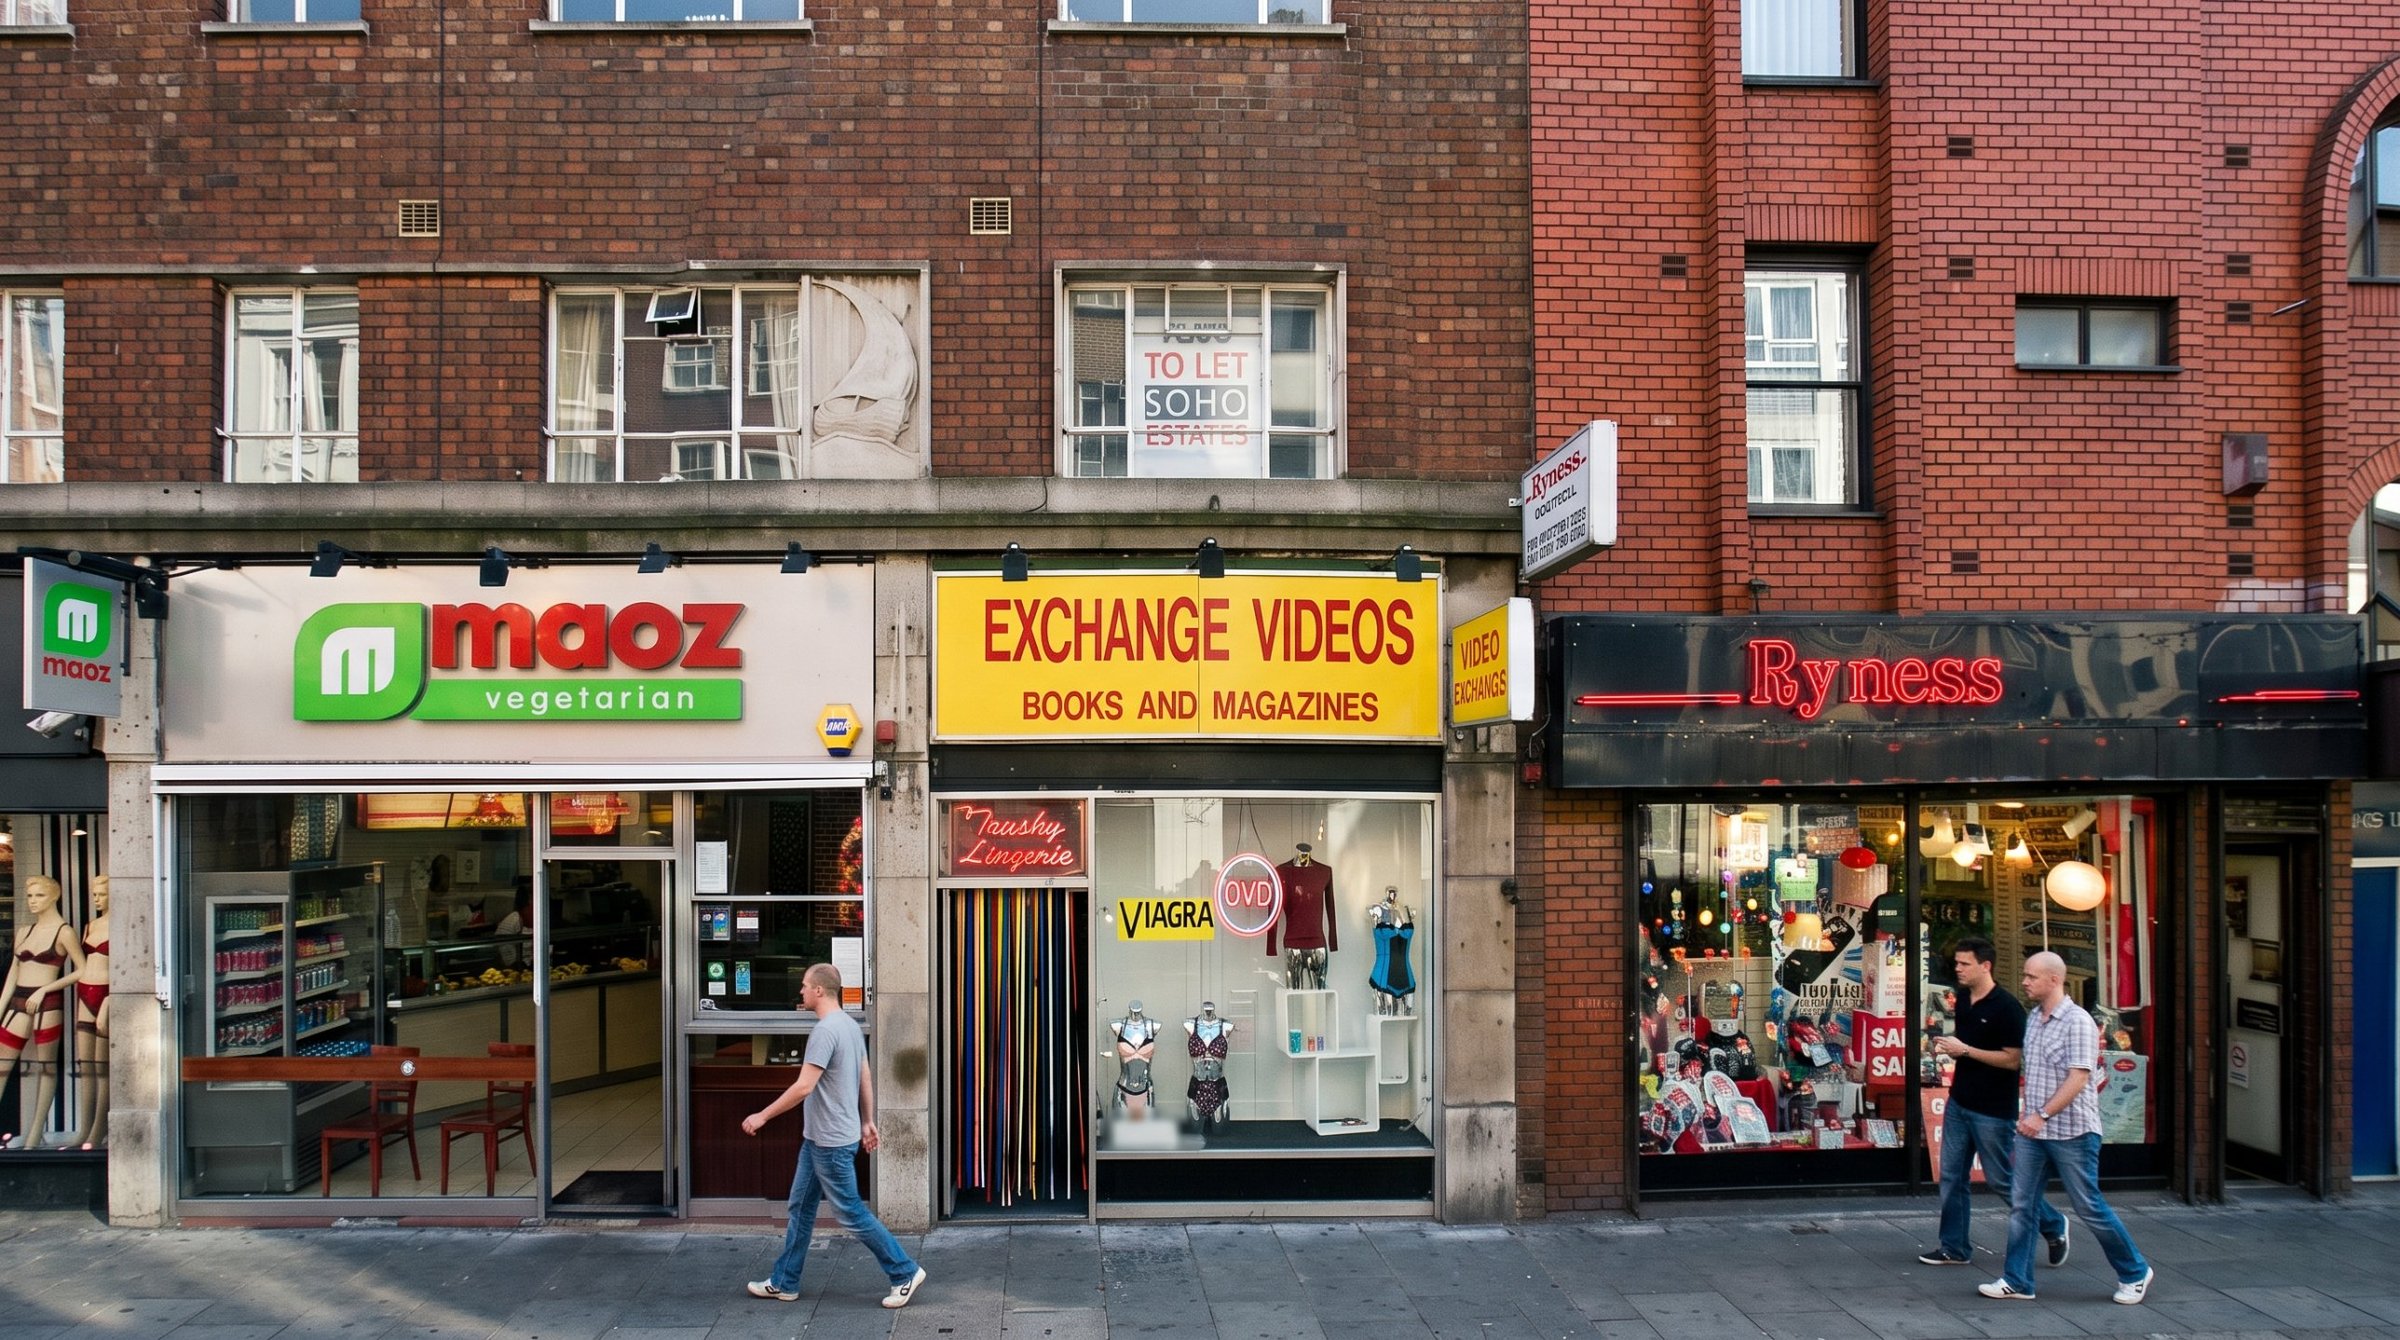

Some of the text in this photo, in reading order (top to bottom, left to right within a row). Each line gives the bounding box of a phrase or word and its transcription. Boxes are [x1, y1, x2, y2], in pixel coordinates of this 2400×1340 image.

[1144, 351, 1249, 379] TO LET
[1145, 388, 1247, 417] SOHO
[1146, 424, 1249, 446] ESTATES
[1531, 450, 1581, 500] Ryness
[432, 602, 746, 670] maoz
[984, 596, 1415, 666] EXCHANGE VIDEOS
[1460, 629, 1500, 671] VIDEO
[42, 655, 112, 683] maoz
[1750, 638, 2003, 718] Ryness
[485, 685, 695, 715] vegetarian
[1022, 690, 1379, 723] BOOKS AND MAGAZINES
[959, 840, 1074, 873] Lingerie
[1119, 901, 1214, 939] VIAGRA
